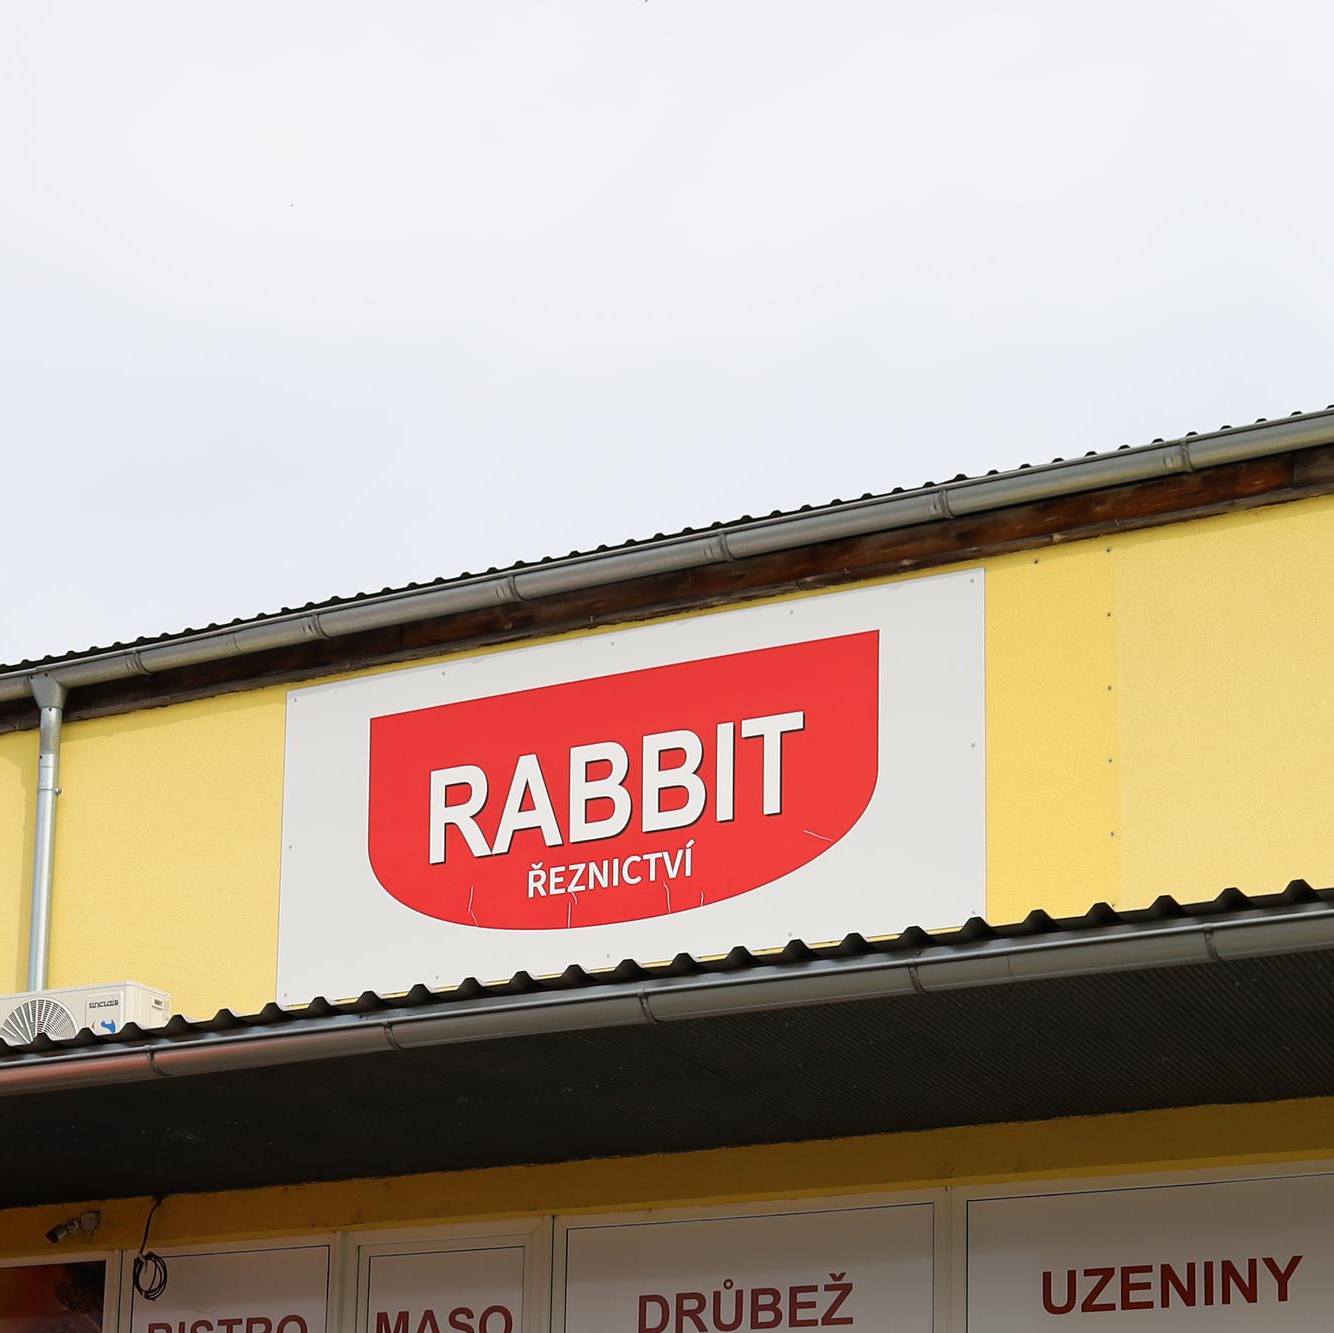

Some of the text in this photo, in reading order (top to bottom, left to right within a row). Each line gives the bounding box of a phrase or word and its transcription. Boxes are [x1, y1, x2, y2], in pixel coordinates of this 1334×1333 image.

[429, 710, 805, 865] RABBIT
[526, 840, 697, 900] ŘEZNICTVÍ
[1041, 1255, 1304, 1315] UZENINY
